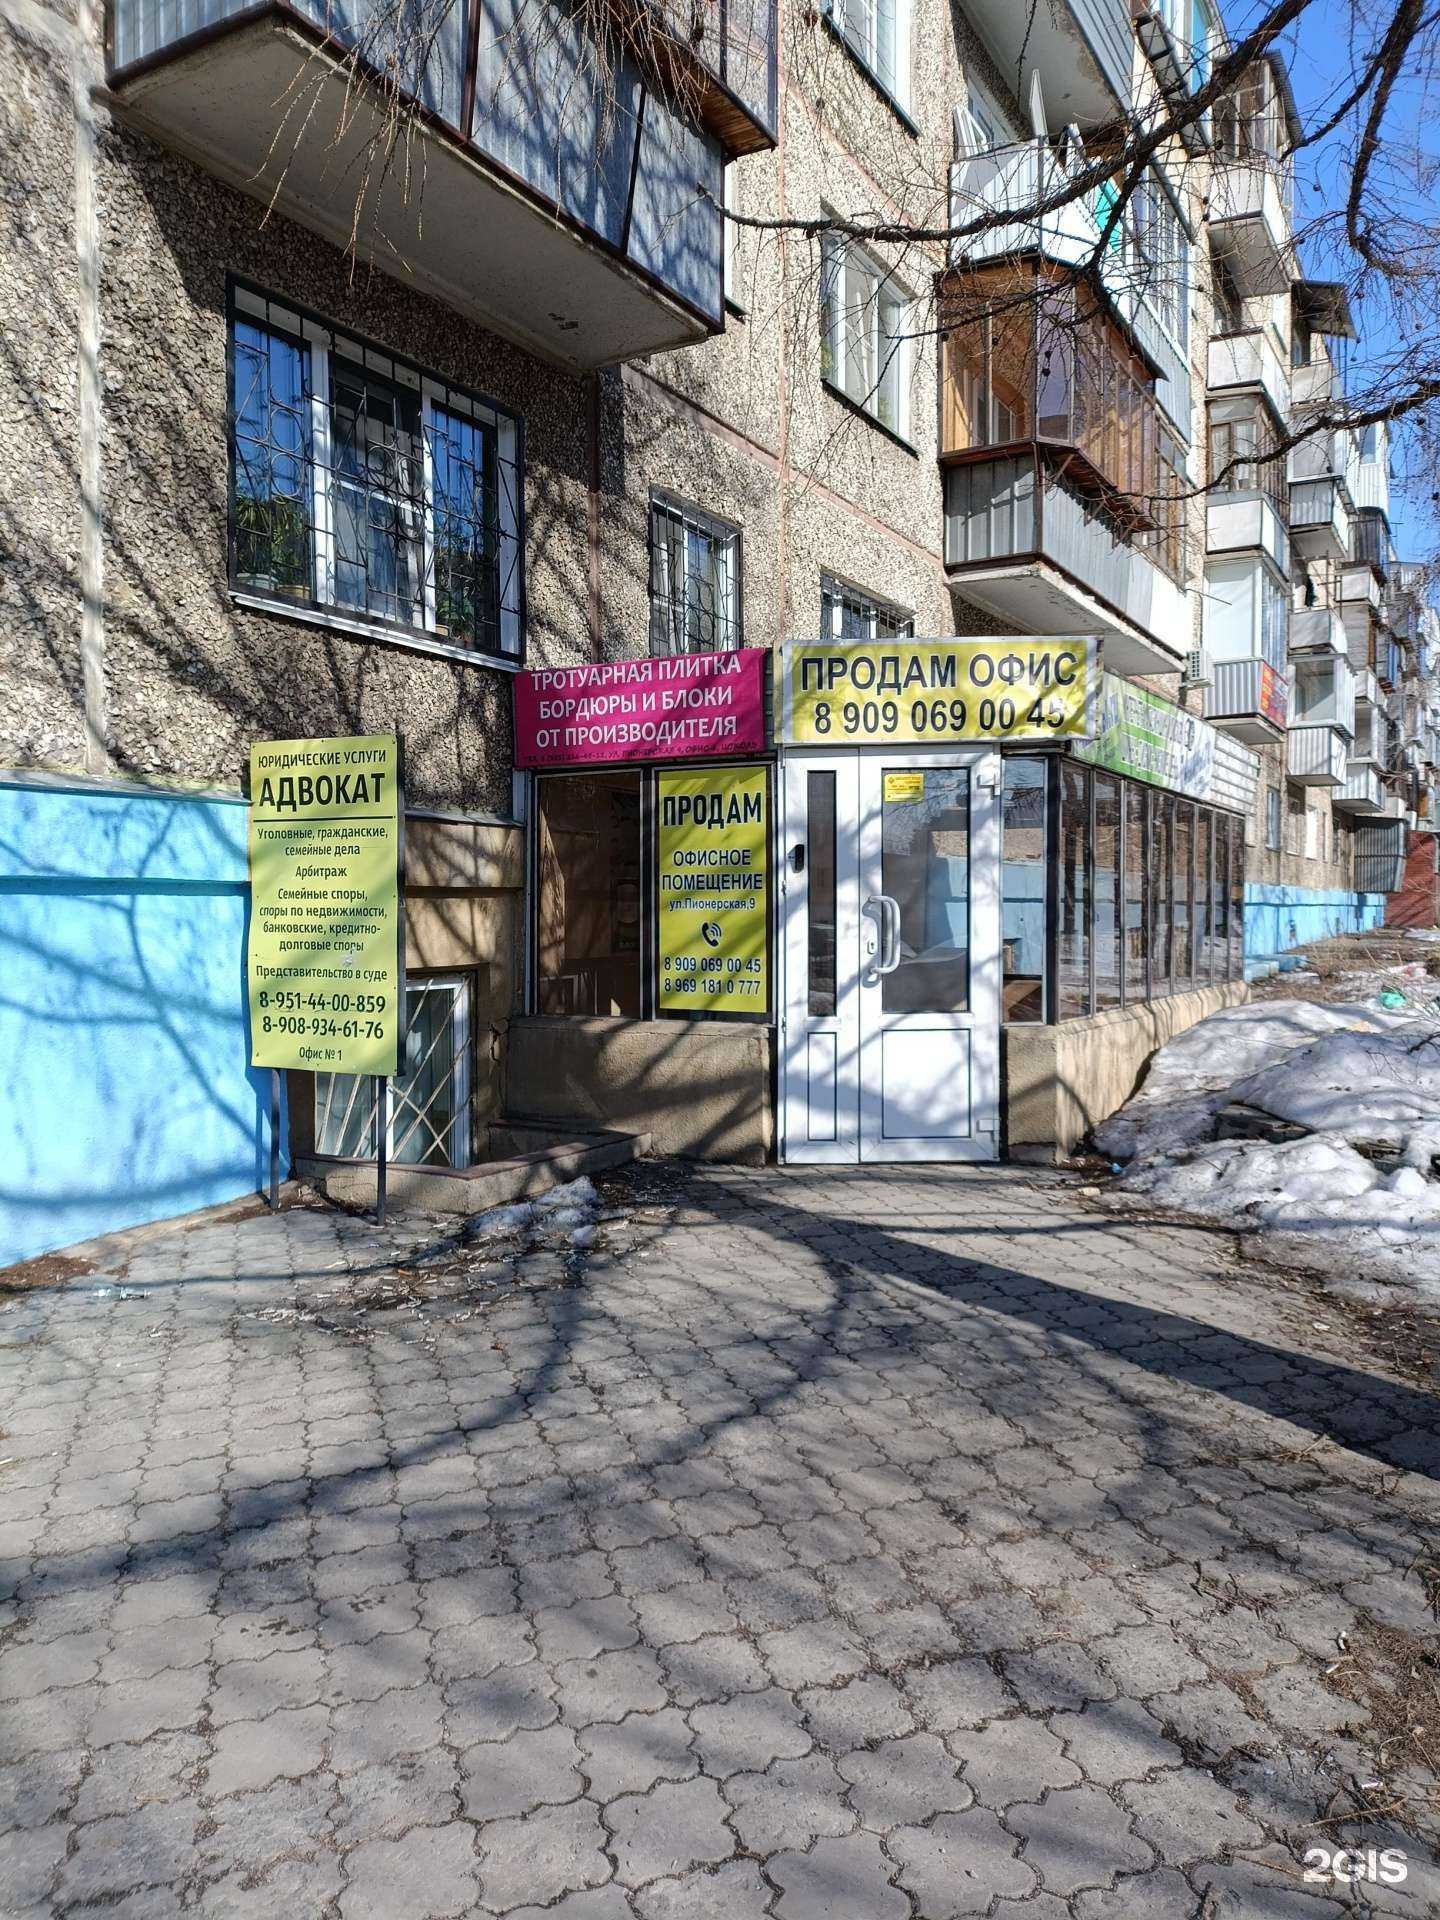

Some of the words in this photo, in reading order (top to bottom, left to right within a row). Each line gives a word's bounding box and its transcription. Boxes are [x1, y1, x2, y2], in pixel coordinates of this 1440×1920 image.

[531, 666, 652, 691] ТРОТУАРНАЯ
[658, 654, 742, 680] ПЛИТКА
[802, 654, 956, 696] ПРОДАМ
[969, 652, 1078, 688] ОФИС
[540, 693, 637, 721] БОРДЮРЫ
[642, 692, 656, 711] И
[662, 686, 732, 710] БЛОКИ
[815, 702, 832, 734] 8
[843, 701, 899, 734] 909
[911, 699, 967, 733] 069
[979, 698, 1016, 731] 00
[1026, 697, 1065, 729] 45
[536, 729, 560, 748] ОТ
[566, 716, 737, 746] ПРОИЗВОДИТЕЛЯ
[258, 752, 341, 769] ЮРИДИЧЕСКИЕ
[344, 749, 387, 765] УСЛУГИ
[259, 773, 386, 812] АДВОКАТ
[663, 792, 762, 830] ПРОДАМ
[257, 827, 315, 841] Уголовные,
[317, 826, 389, 842] гражданские,
[285, 844, 333, 857] семейные
[334, 844, 361, 858] дела
[673, 849, 752, 867] ОФИСНОЕ
[295, 865, 348, 881] Арбитраж
[662, 874, 763, 892] ПОМЕЩЕНИЕ
[278, 888, 329, 901] Семейные
[331, 889, 369, 903] споры,
[259, 905, 288, 920] споры
[290, 906, 304, 917] по
[306, 906, 388, 918] недвижимости,
[263, 921, 327, 935] банковские,
[329, 924, 381, 937] кредитно-
[279, 939, 332, 952] долговые
[333, 941, 364, 954] споры
[256, 965, 353, 980] Представительство
[355, 970, 361, 979] в
[363, 970, 388, 982] суде
[664, 957, 671, 971] 8
[675, 957, 697, 972] 909
[701, 957, 723, 972] 069
[727, 957, 742, 973] 00
[745, 958, 761, 973] 45
[664, 978, 671, 992] 8
[675, 978, 697, 993] 969
[702, 979, 722, 994] 181
[727, 980, 734, 994] 0
[738, 980, 761, 995] 777
[259, 991, 386, 1014] 8-951-44-00-859
[262, 1016, 384, 1039] 8-908-934-61-76
[299, 1046, 323, 1061] Офис
[325, 1048, 335, 1060] №
[337, 1049, 343, 1061] 1
